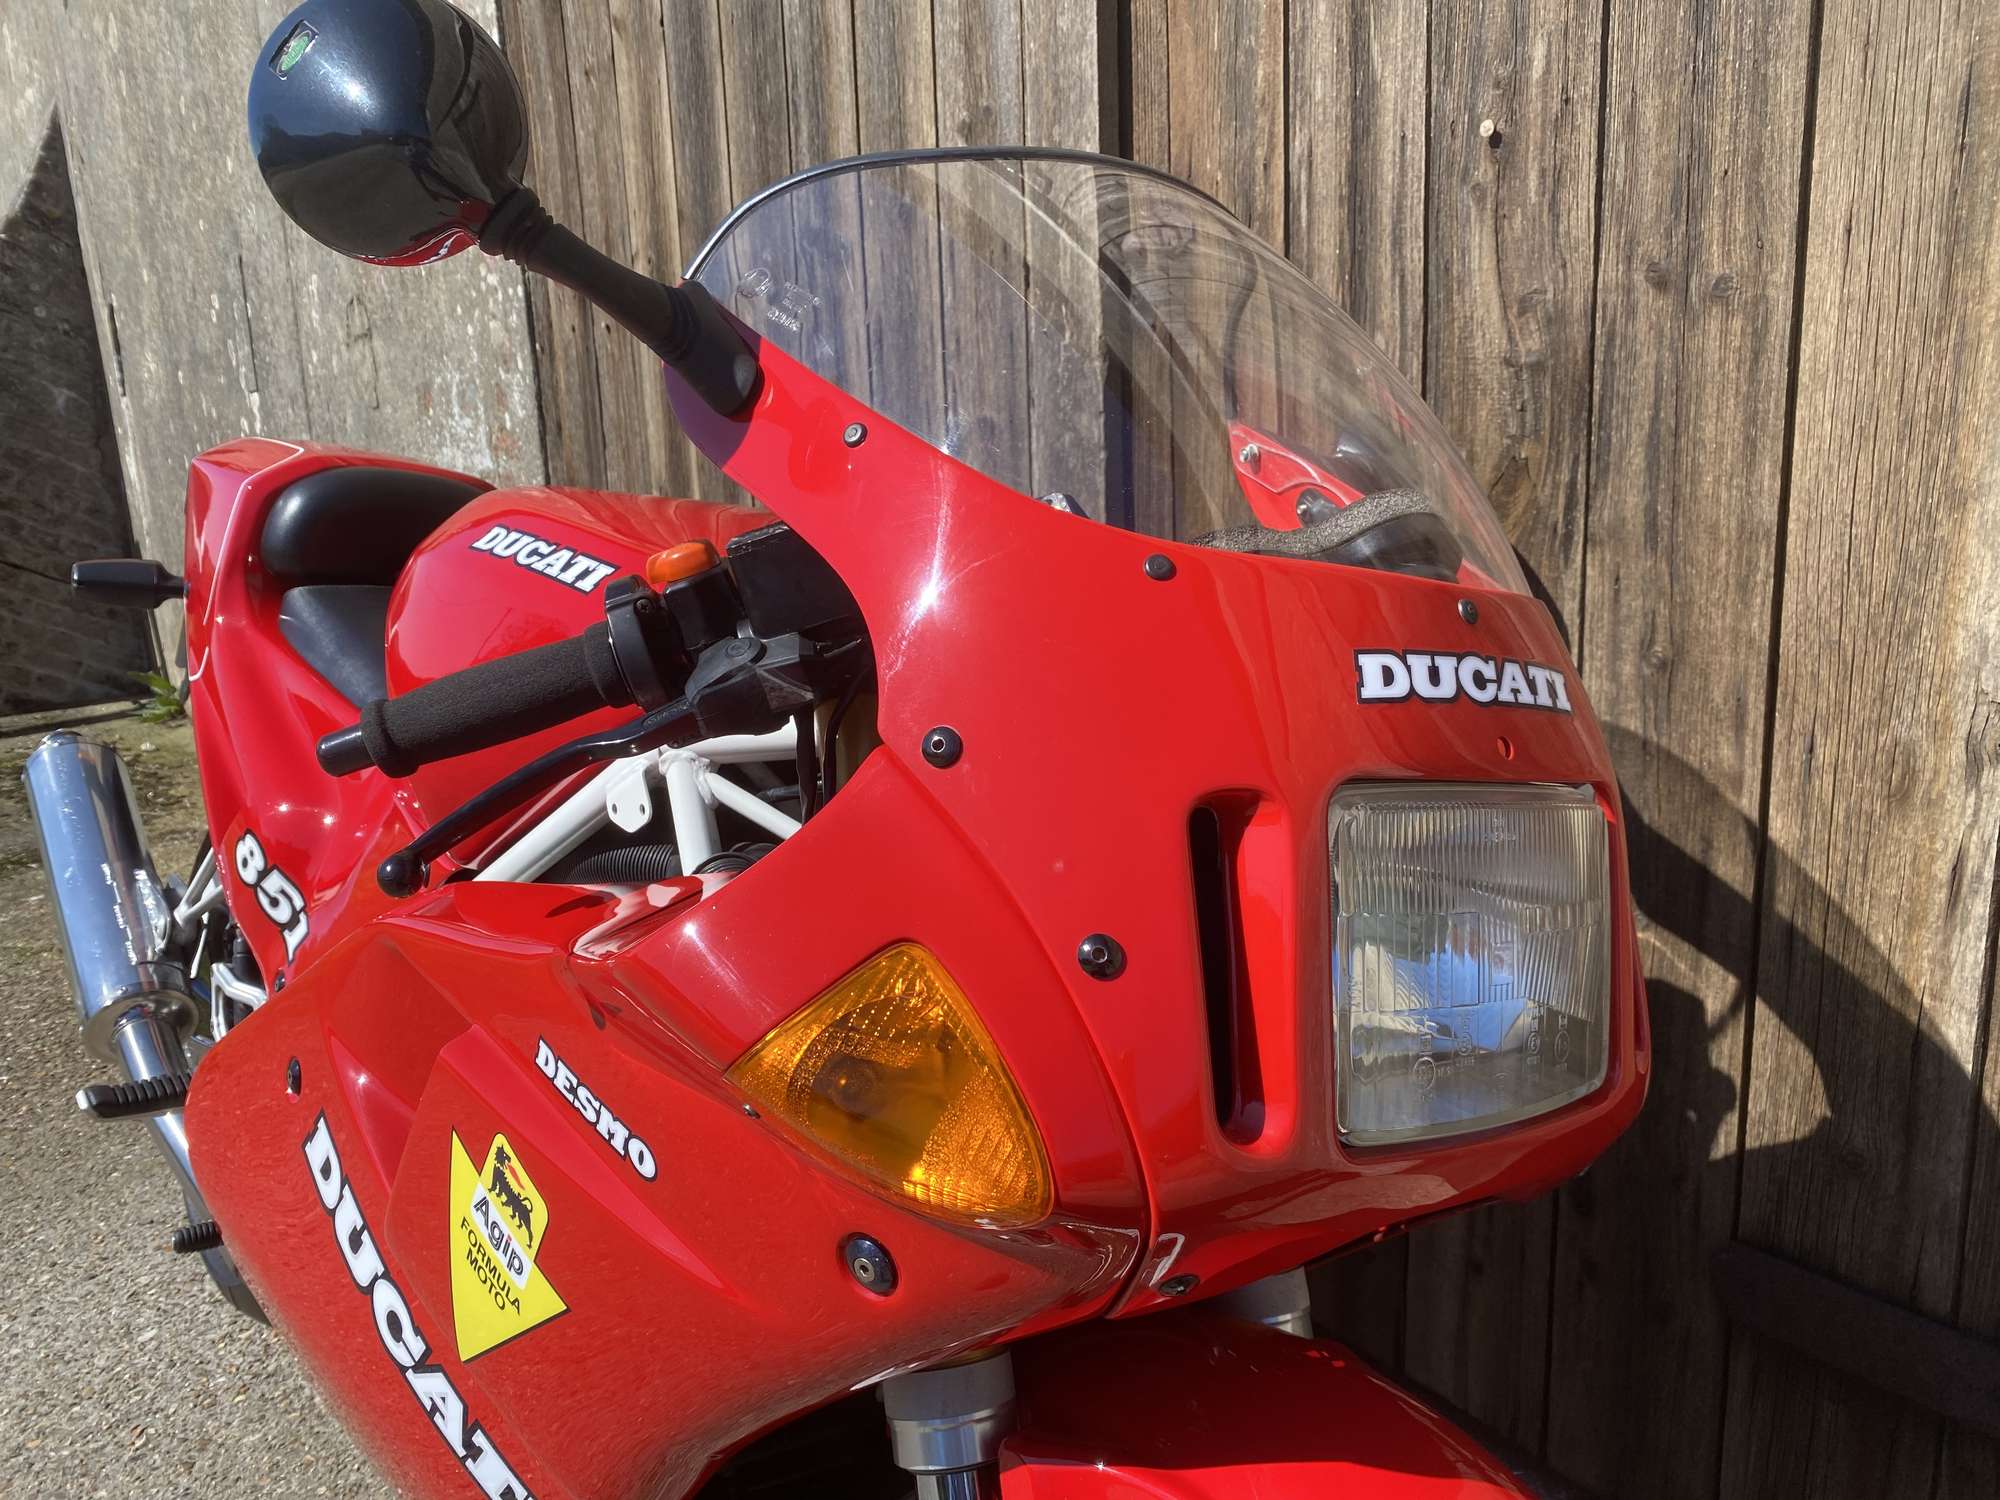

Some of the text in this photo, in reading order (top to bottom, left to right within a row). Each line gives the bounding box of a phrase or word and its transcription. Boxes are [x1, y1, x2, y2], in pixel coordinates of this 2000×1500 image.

[468, 524, 622, 595] DUCATI
[1355, 649, 1573, 714] DUCATI
[234, 829, 310, 965] 851
[534, 1035, 658, 1182] DESMO
[461, 1216, 521, 1316] FORMULA
[466, 1250, 506, 1311] MOTO
[473, 1196, 524, 1277] Agip
[302, 1109, 535, 1500] DUCAT
